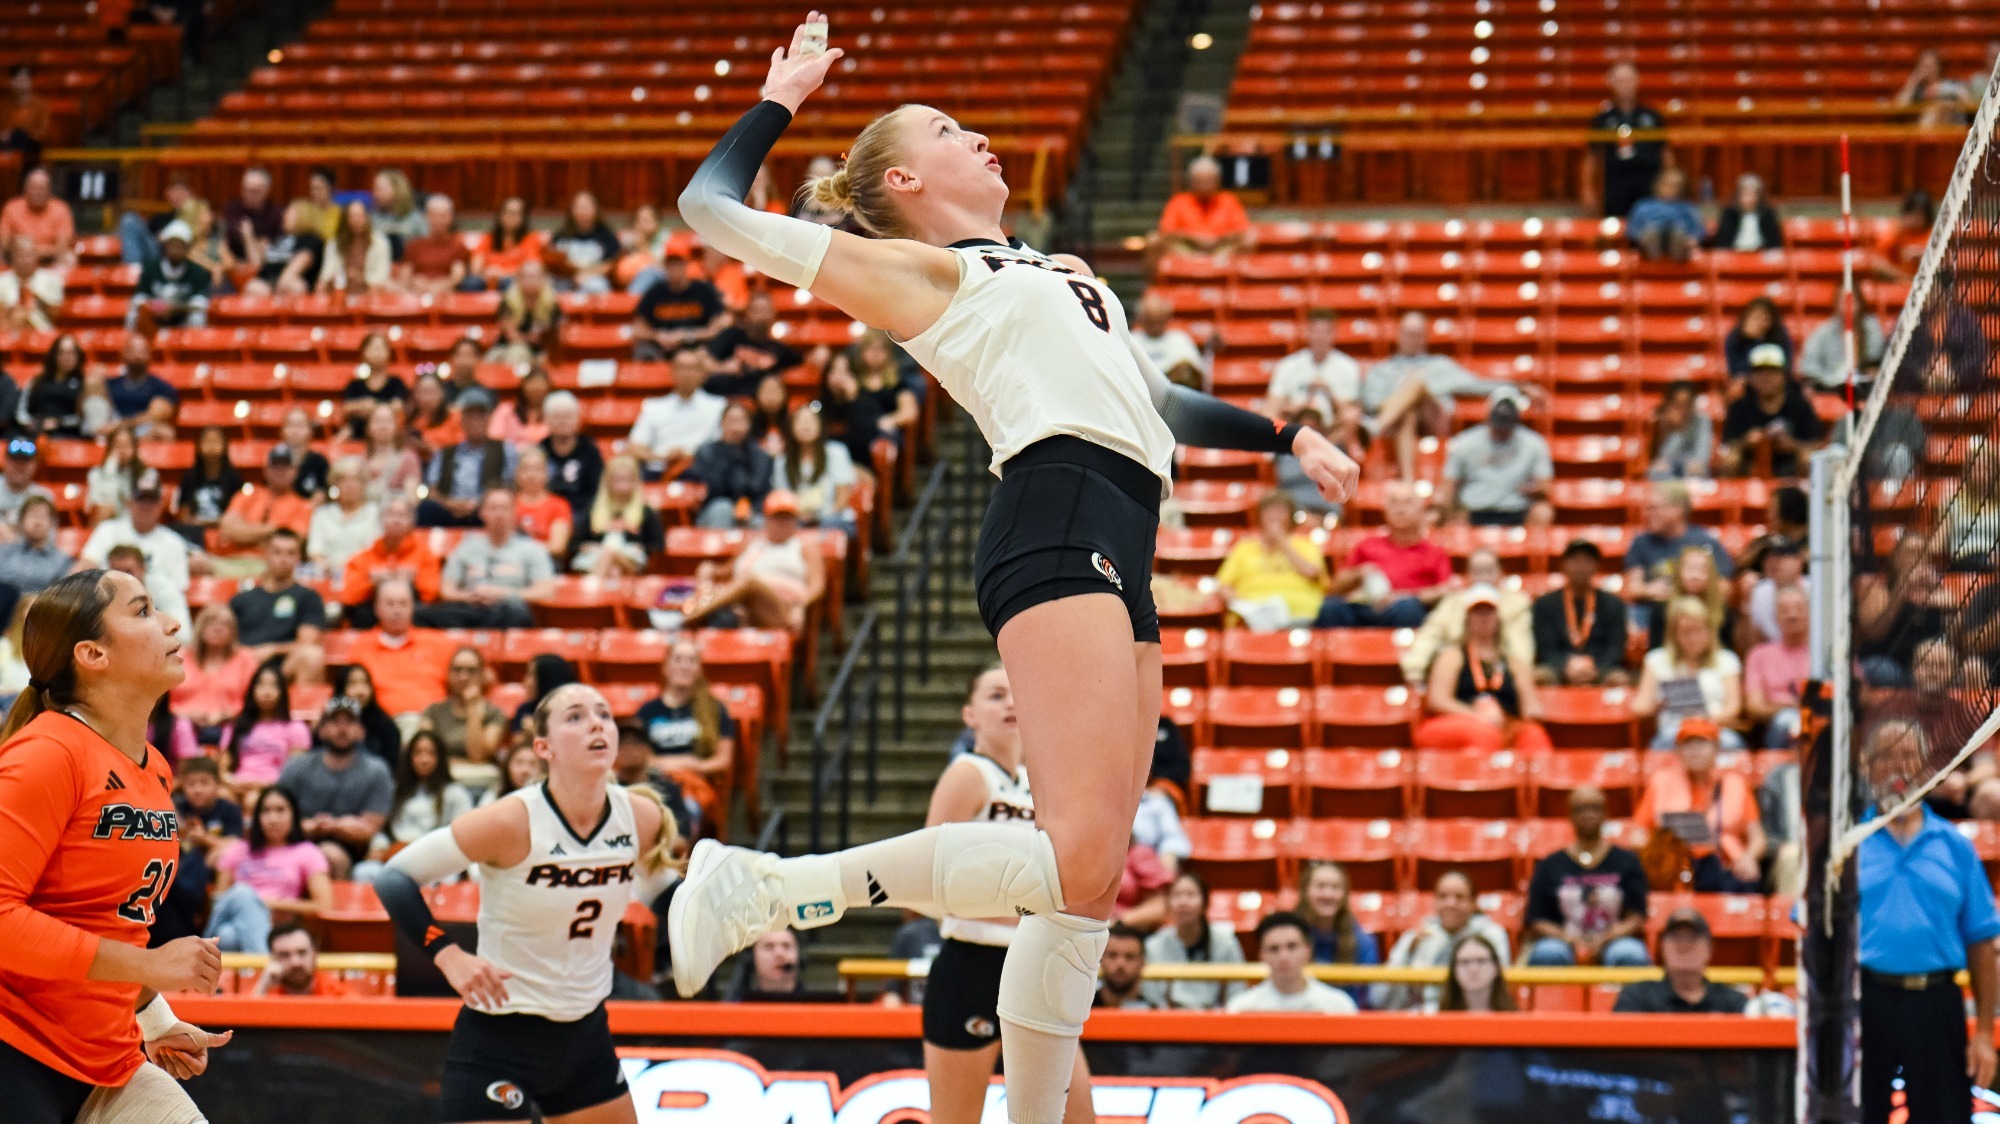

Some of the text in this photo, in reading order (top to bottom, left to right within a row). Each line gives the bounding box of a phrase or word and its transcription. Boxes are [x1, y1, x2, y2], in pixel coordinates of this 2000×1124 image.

[1067, 279, 1110, 334] 8
[93, 803, 179, 841] PACIF
[117, 858, 175, 924] 21
[568, 899, 603, 940] 2
